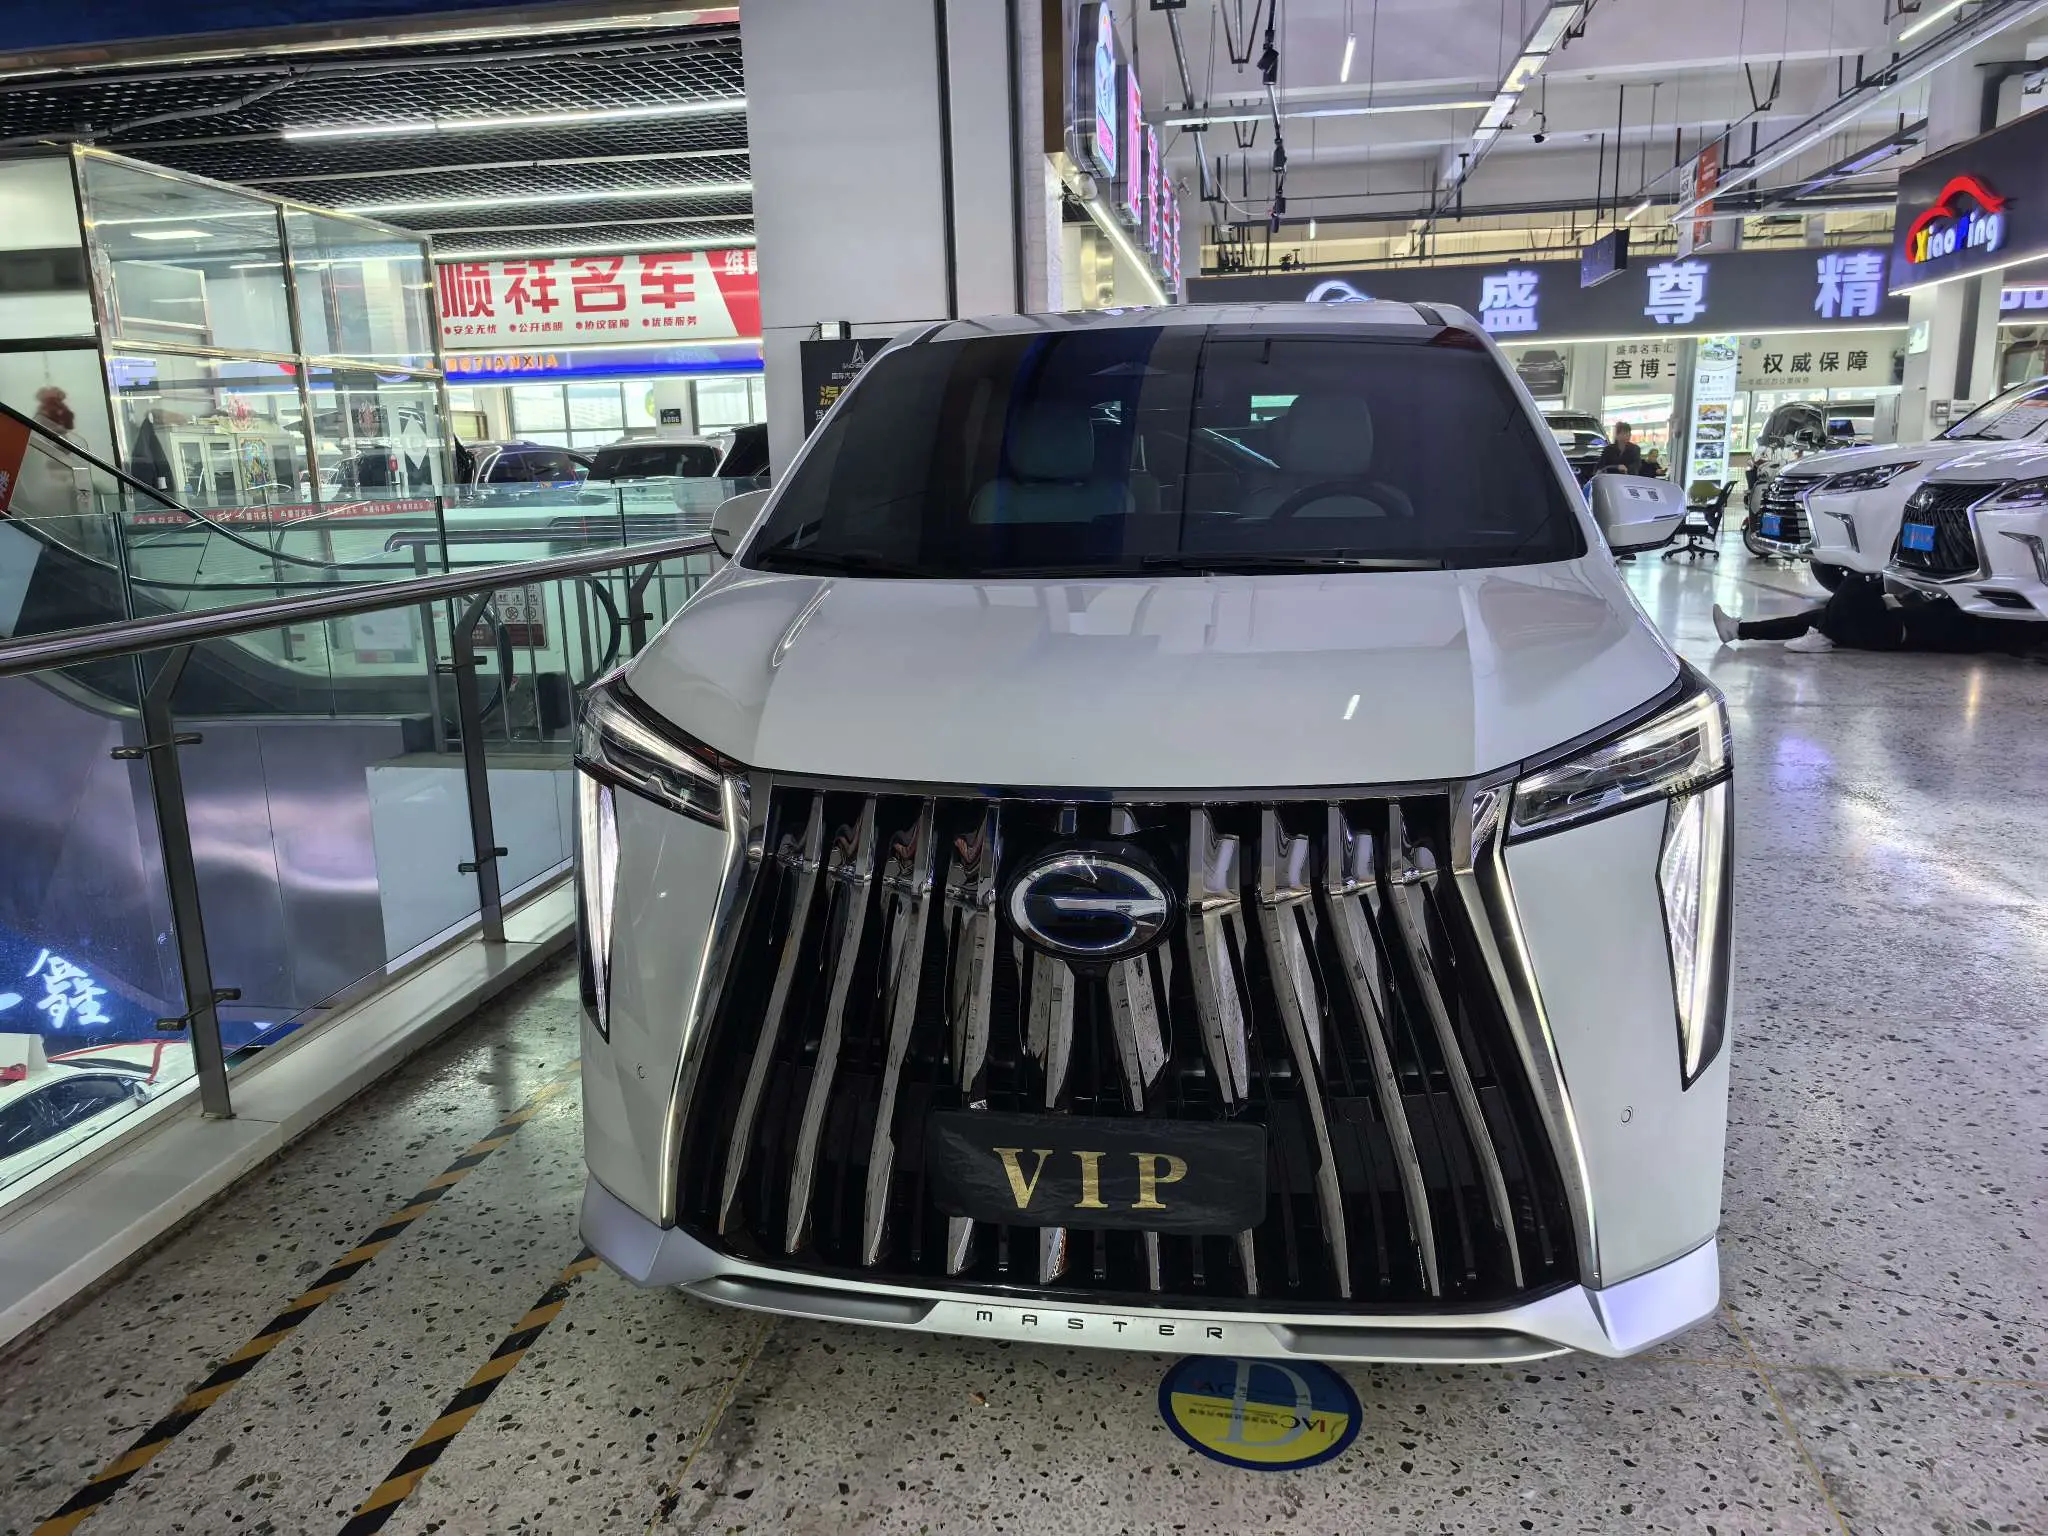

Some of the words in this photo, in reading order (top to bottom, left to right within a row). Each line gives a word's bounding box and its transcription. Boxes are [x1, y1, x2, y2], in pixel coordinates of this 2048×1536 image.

[438, 251, 696, 318] 顺祥名车
[453, 323, 497, 335] 安全无忧
[519, 320, 563, 333] 公开透明
[1762, 350, 1869, 375] 权威保障
[820, 386, 848, 406] 汽
[993, 1147, 1188, 1209] VIP
[976, 1310, 1223, 1340] MASTER
